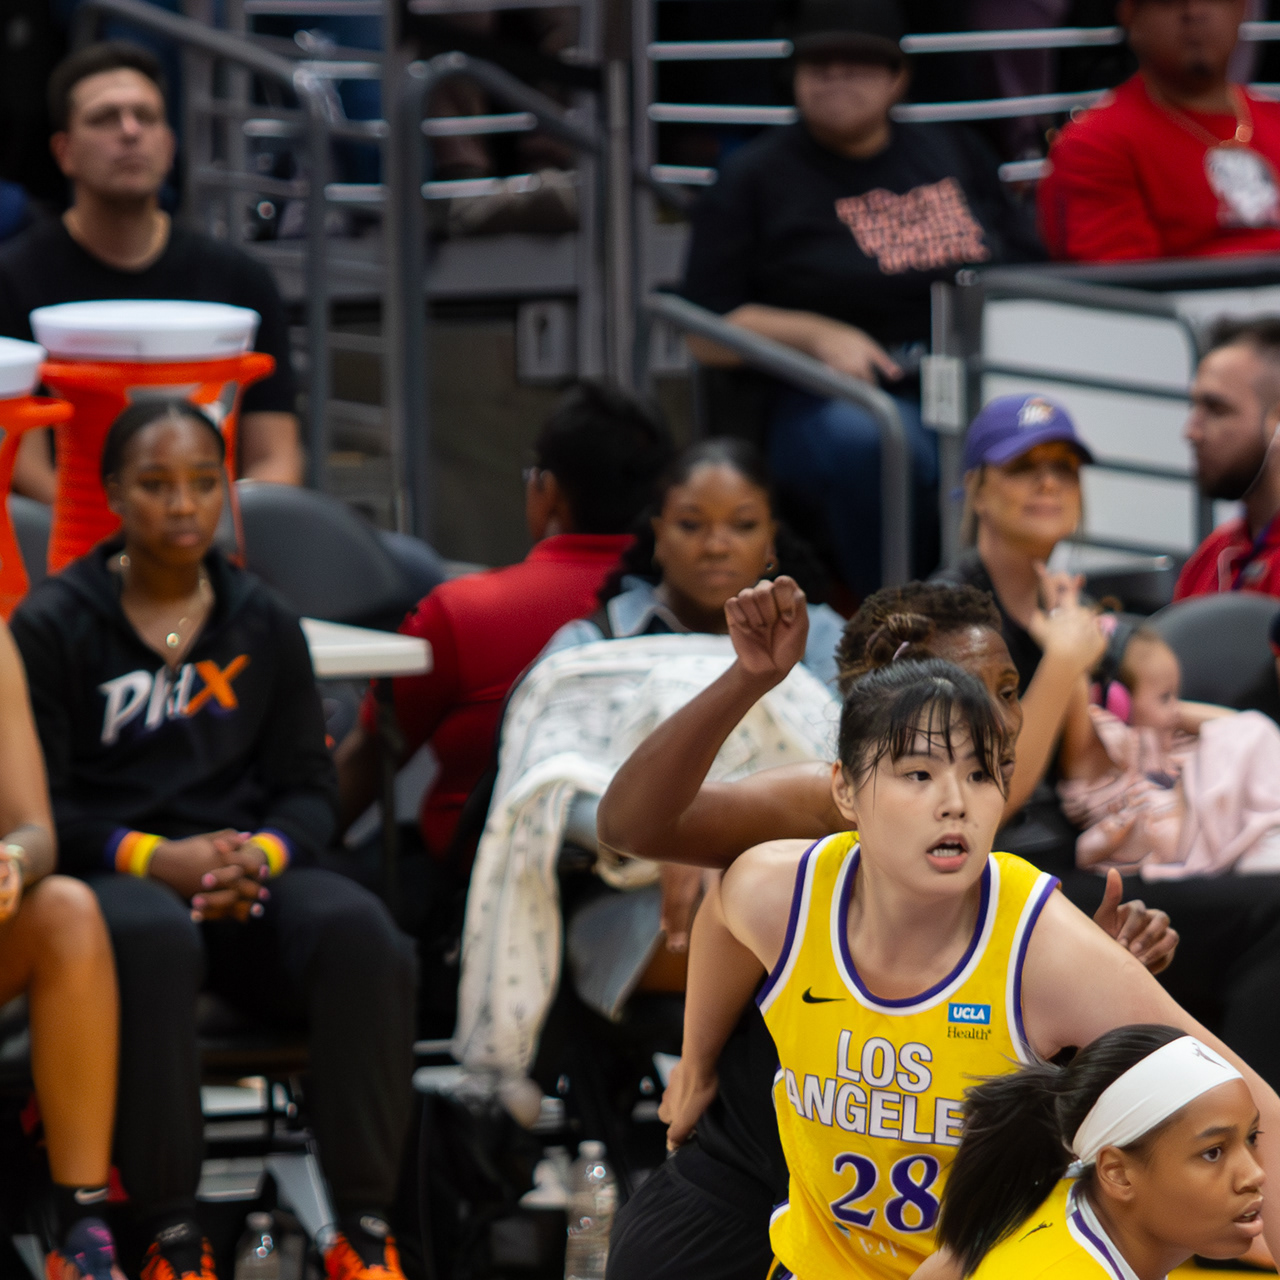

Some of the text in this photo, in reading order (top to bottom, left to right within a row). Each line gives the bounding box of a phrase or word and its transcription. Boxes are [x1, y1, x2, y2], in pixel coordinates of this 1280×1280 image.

[952, 1006, 985, 1021] UCLA
[836, 1028, 933, 1093] LOS
[784, 1067, 967, 1146] ANGELE
[828, 1151, 941, 1235] 28
